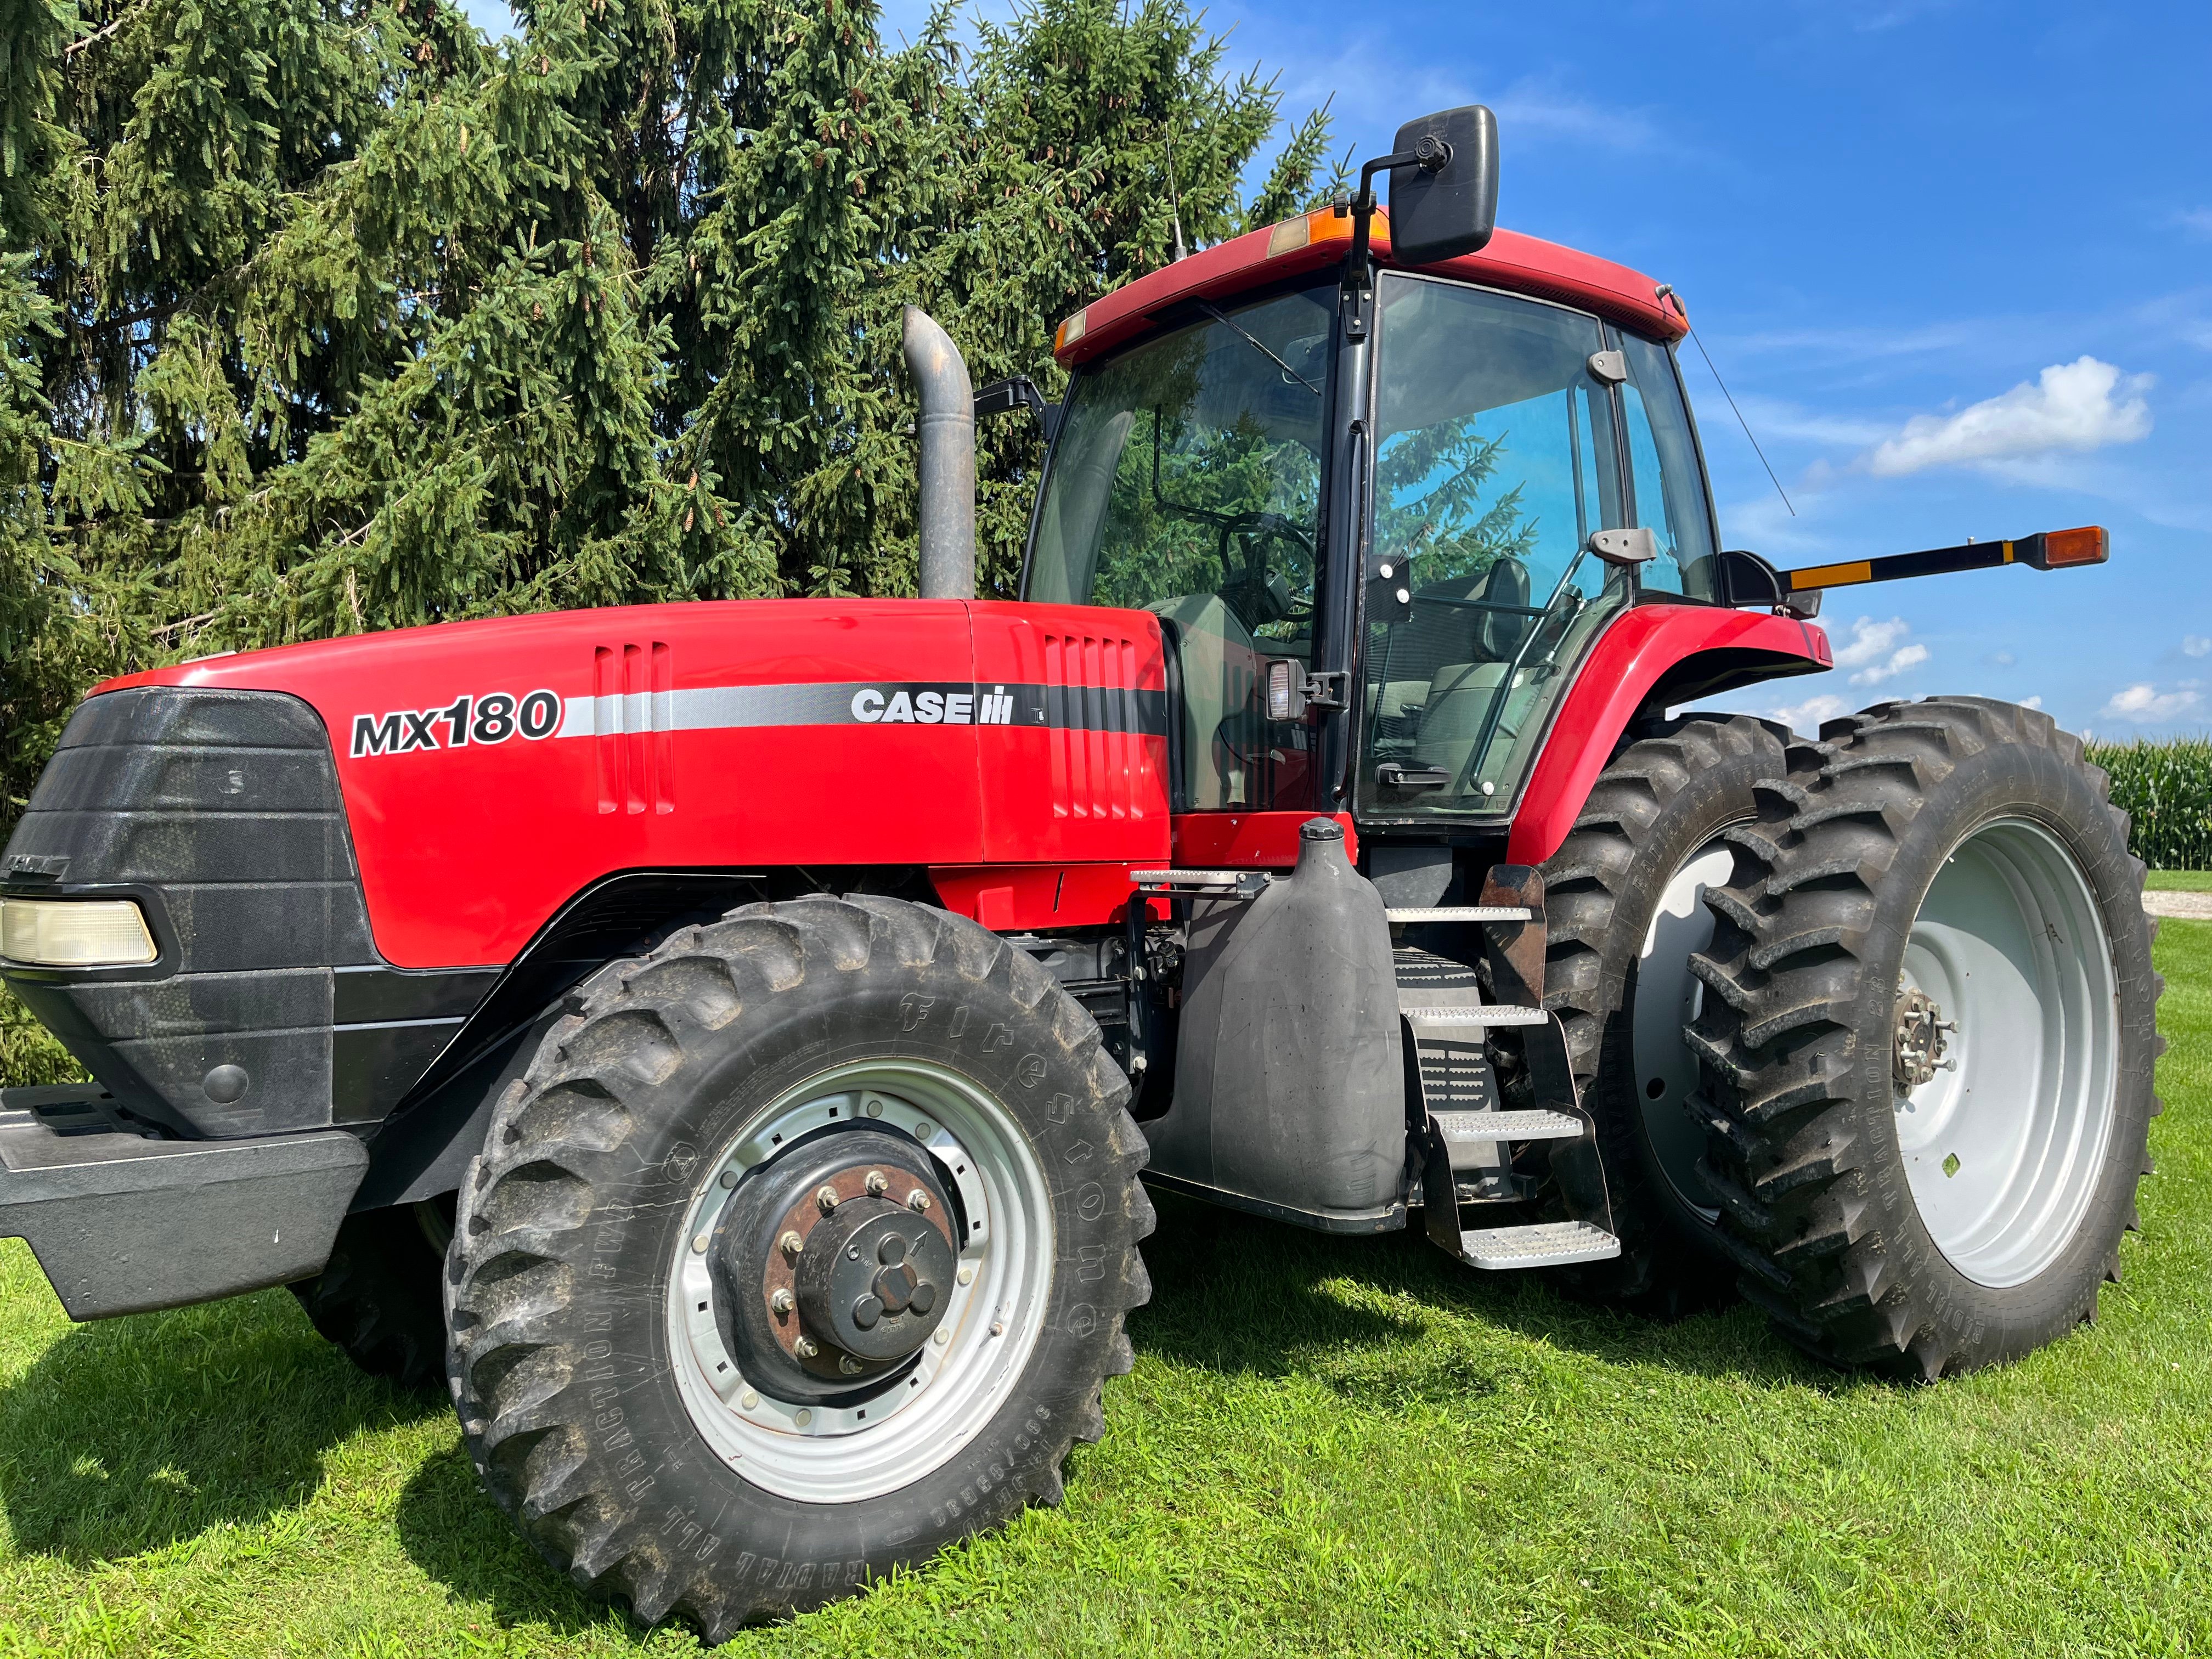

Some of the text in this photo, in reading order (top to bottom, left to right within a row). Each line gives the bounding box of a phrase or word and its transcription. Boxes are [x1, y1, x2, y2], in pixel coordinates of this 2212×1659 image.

[349, 689, 561, 758] MX180
[851, 689, 973, 724] CASE
[1865, 1044, 1898, 1211] TRACTION
[1893, 1223, 1922, 1277] ALL
[1926, 1280, 1985, 1345] RADIAL
[583, 1198, 865, 1589] RADIAL ALL TRACTION FWD
[931, 1403, 1051, 1528] 380/85R30
